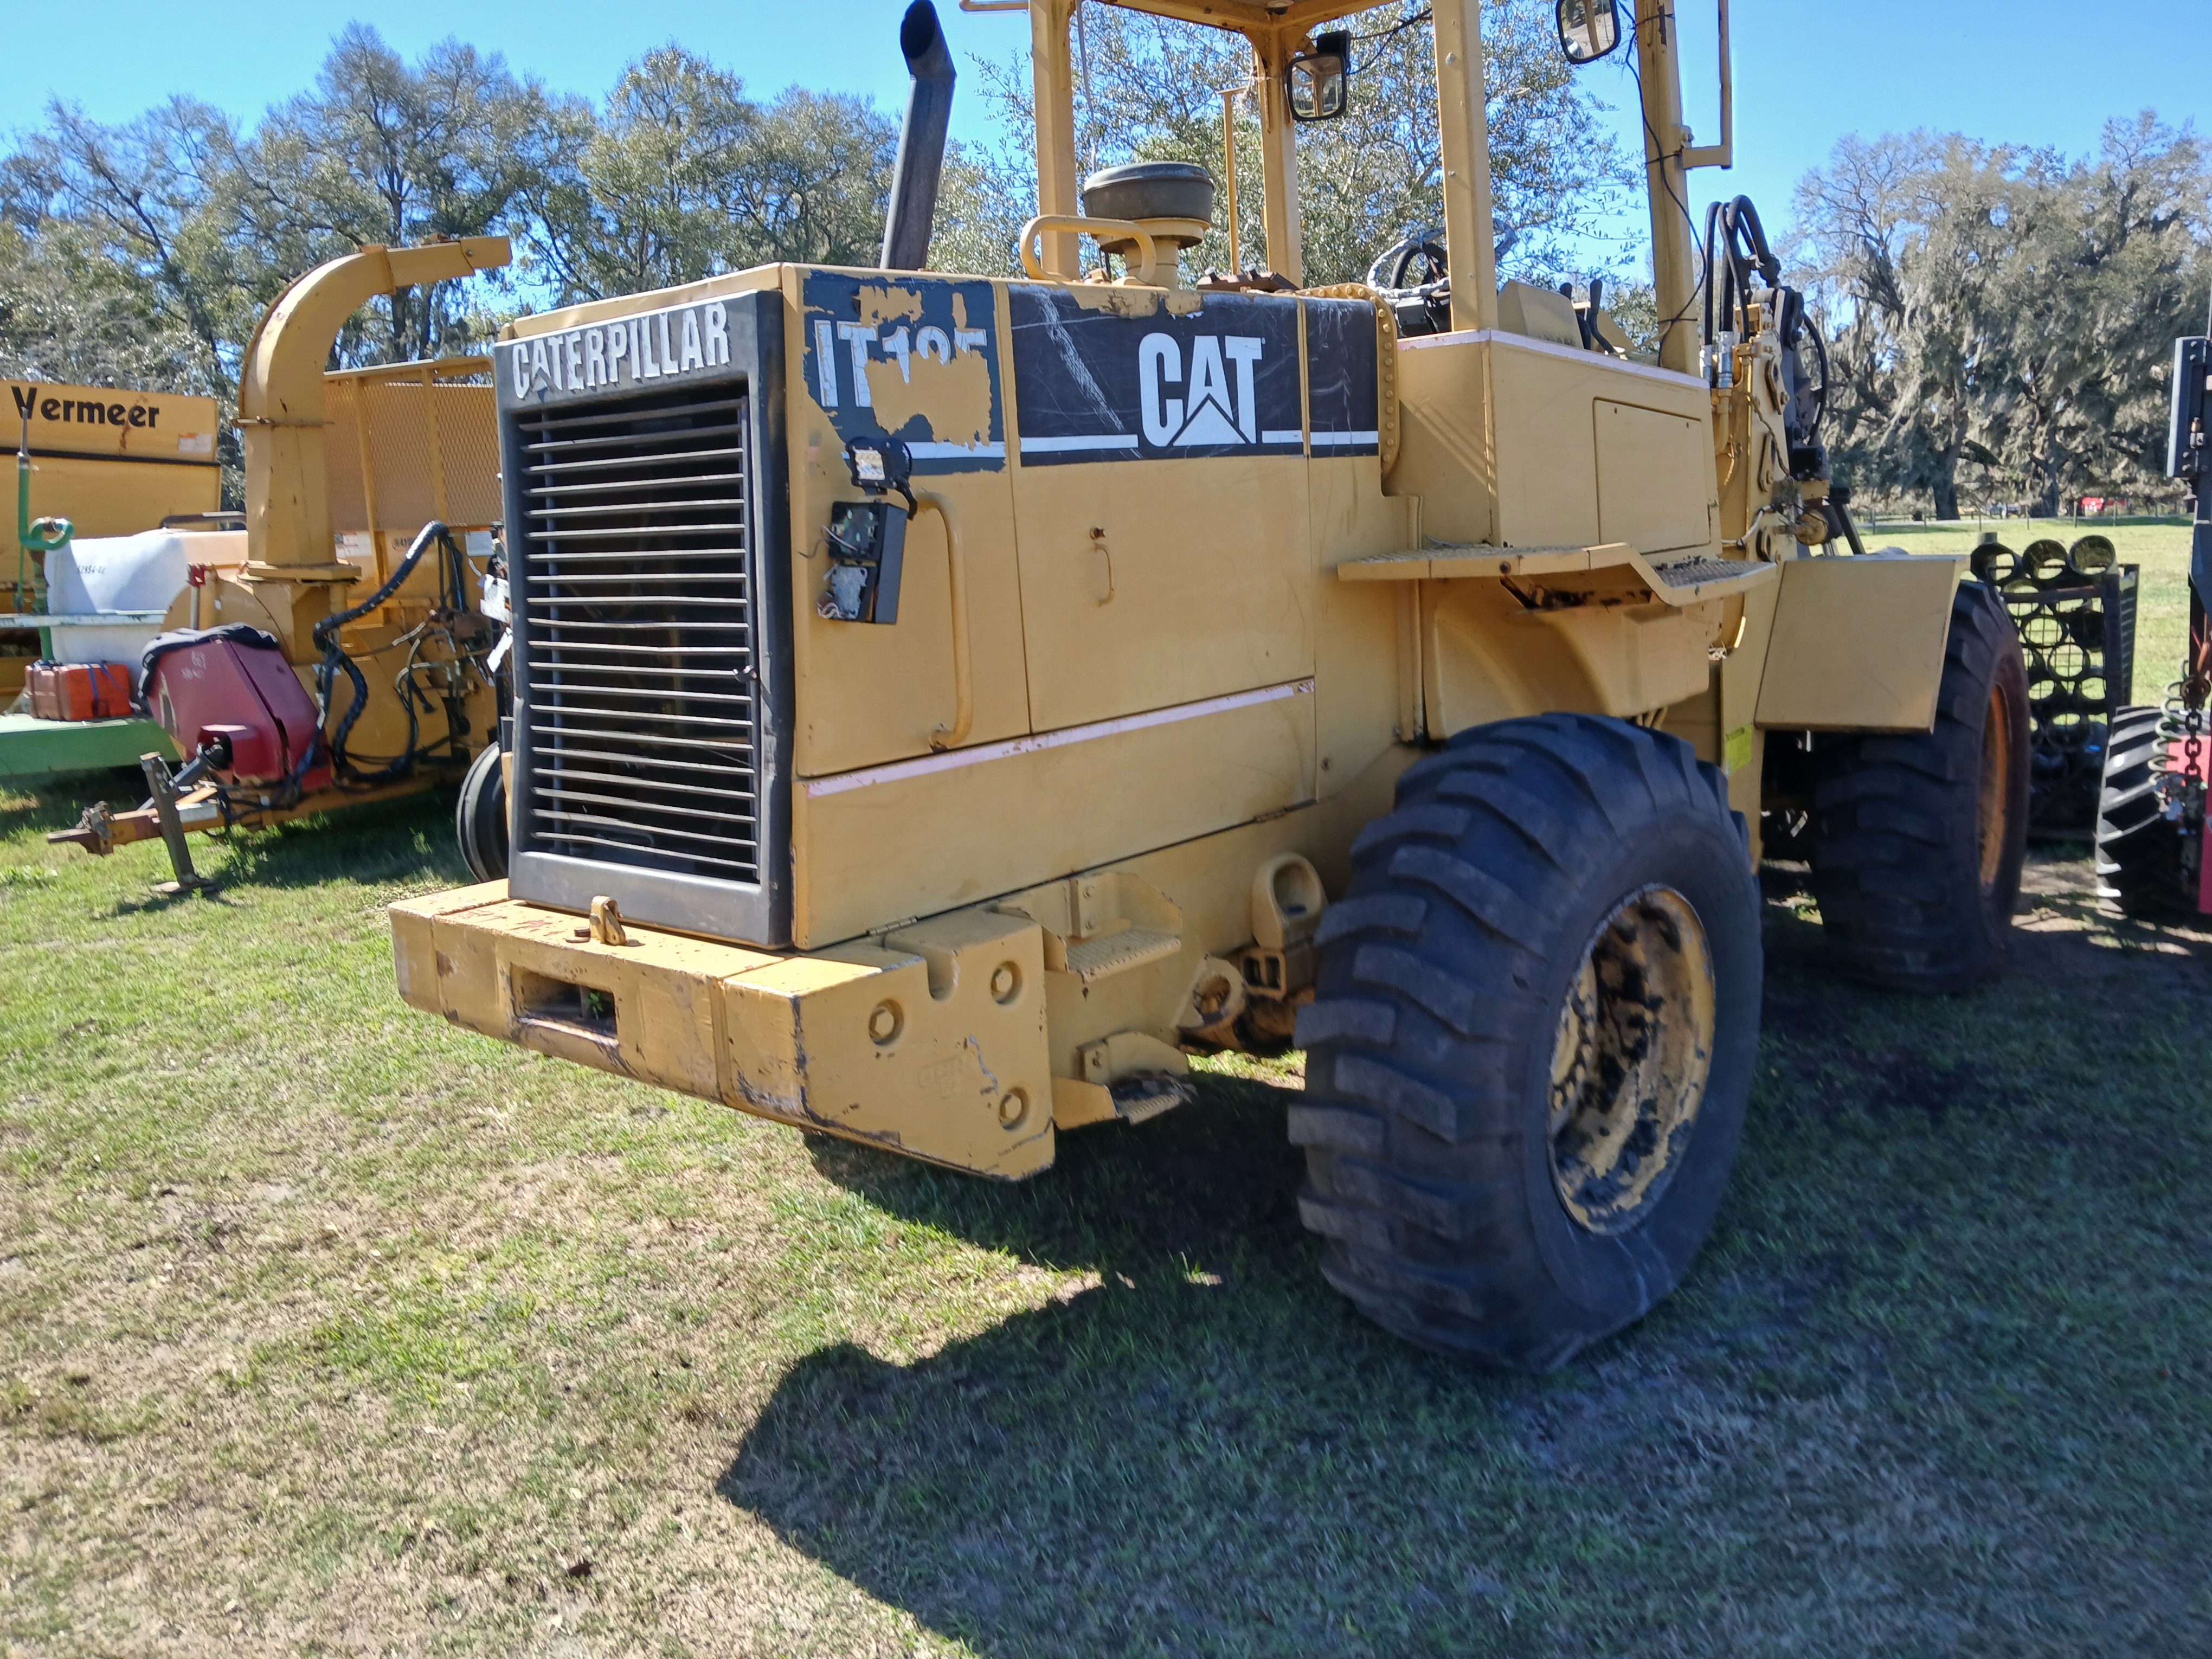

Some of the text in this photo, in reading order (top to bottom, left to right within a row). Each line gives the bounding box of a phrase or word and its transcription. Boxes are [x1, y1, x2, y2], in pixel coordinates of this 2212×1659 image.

[512, 301, 730, 400] CATERPILLAR
[1139, 332, 1263, 447] CAT
[10, 385, 160, 429] Vermeer
